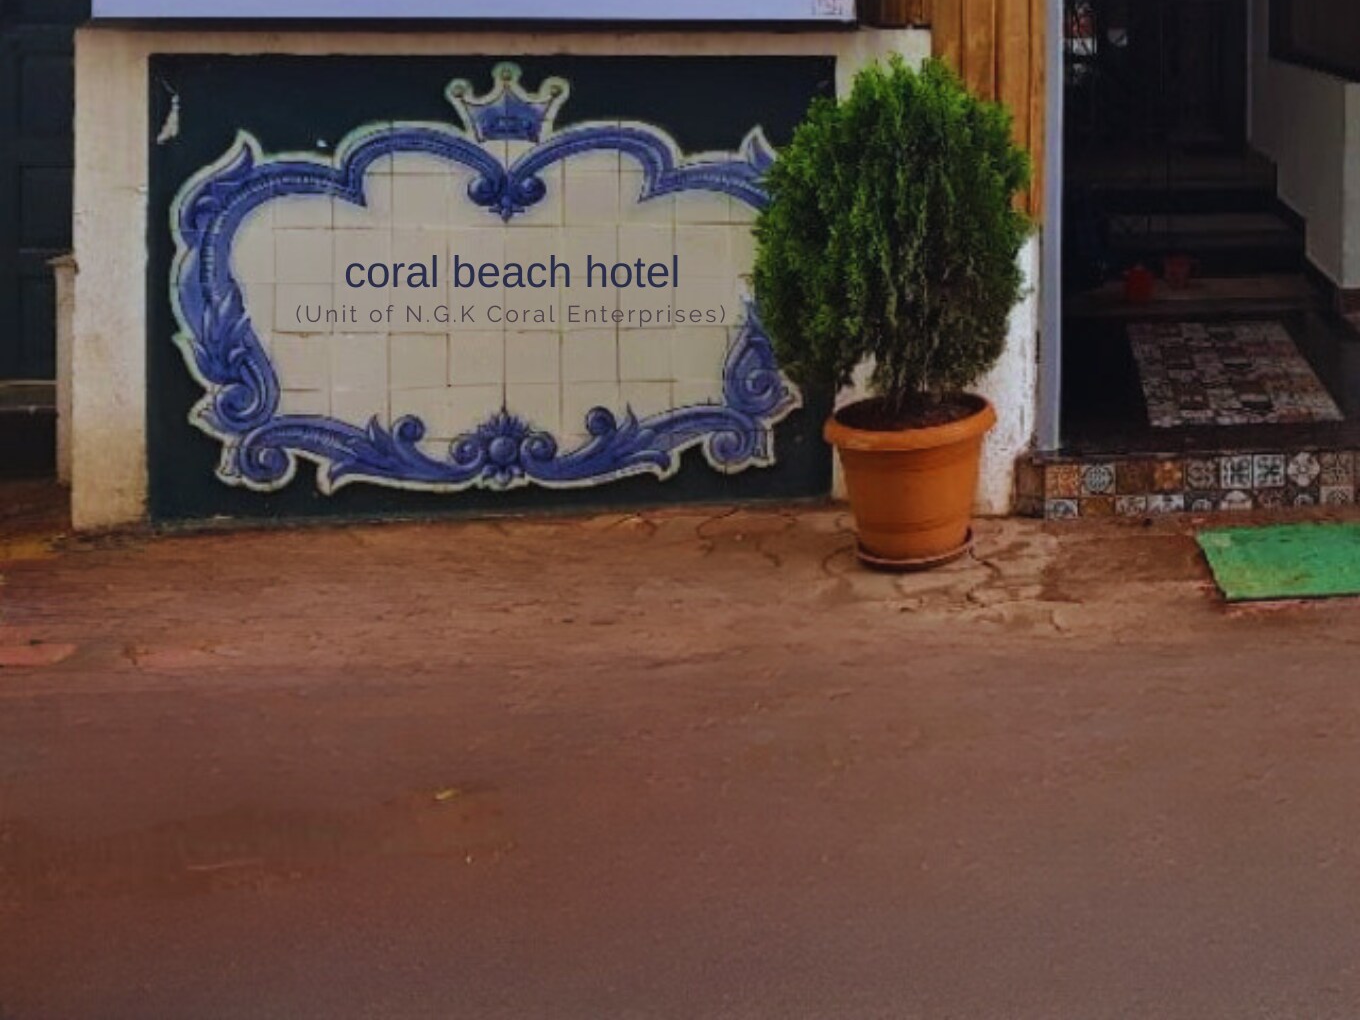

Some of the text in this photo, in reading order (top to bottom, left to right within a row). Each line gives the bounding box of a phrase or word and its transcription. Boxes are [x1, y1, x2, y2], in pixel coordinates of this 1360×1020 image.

[345, 255, 679, 289] coral beach hotel
[296, 303, 726, 327] (Unit of N.G.K Coral Enterprises)
